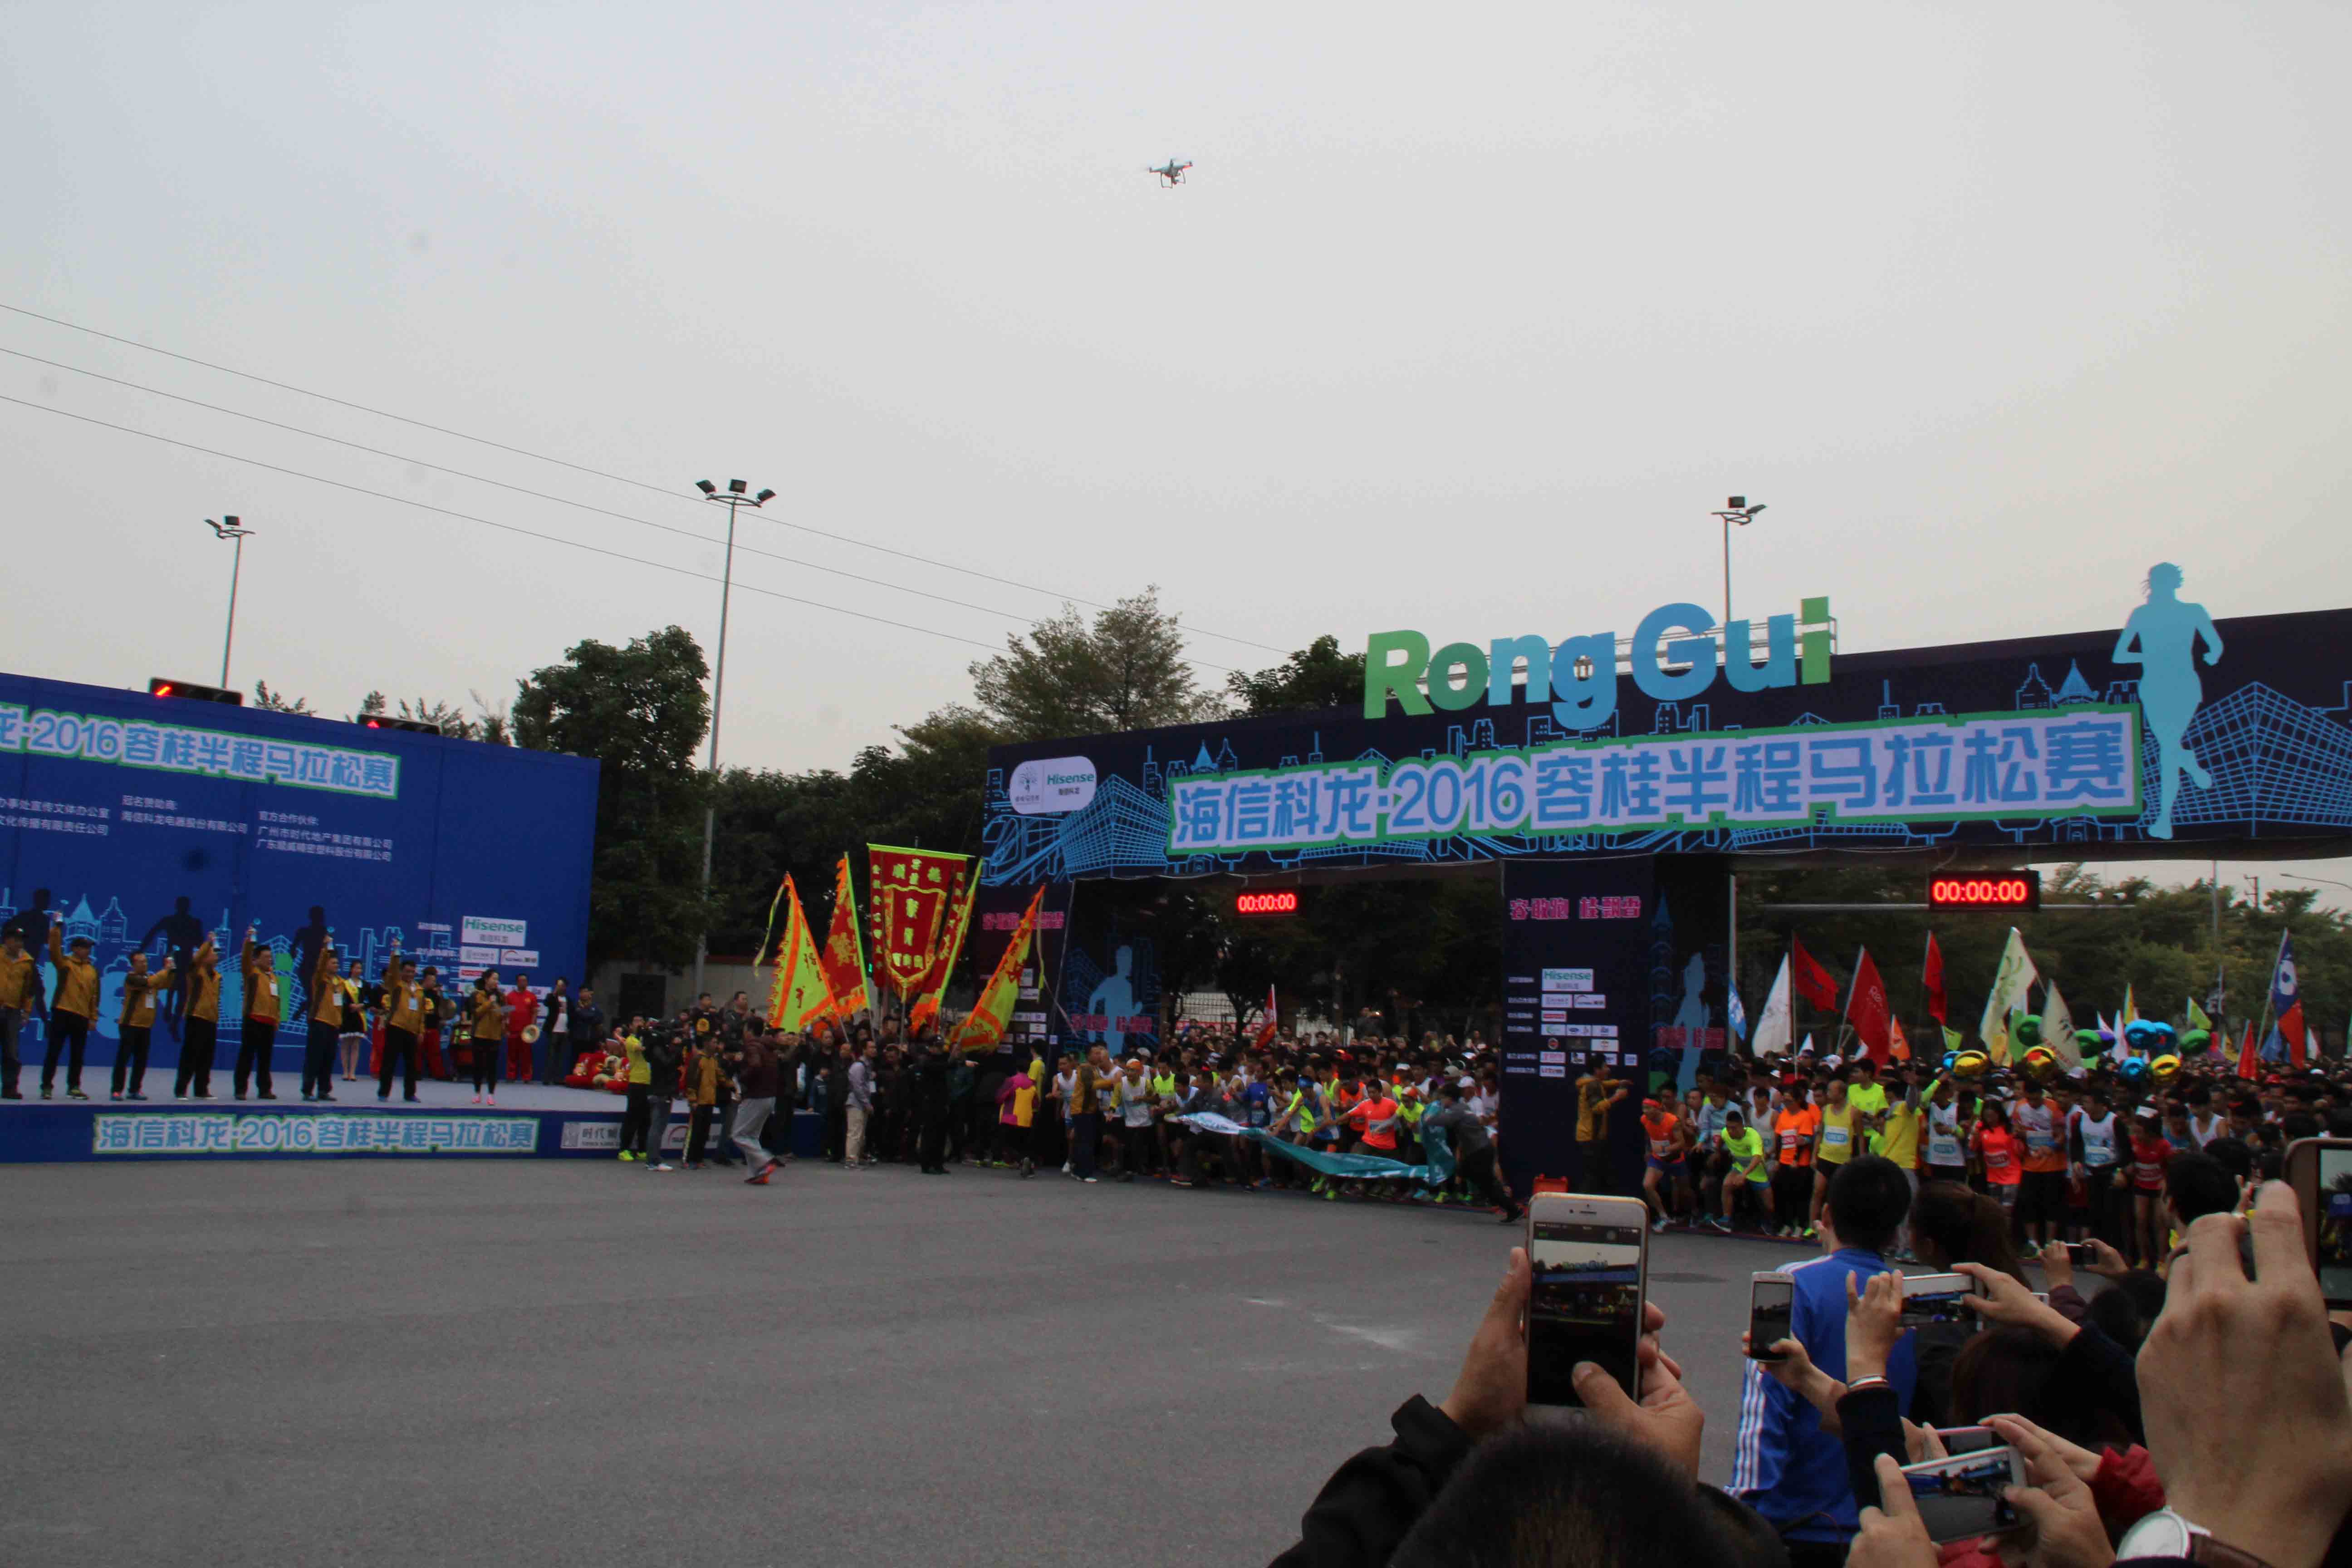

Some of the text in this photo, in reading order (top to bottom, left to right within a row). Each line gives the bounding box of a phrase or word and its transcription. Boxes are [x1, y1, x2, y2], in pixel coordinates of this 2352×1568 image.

[1364, 596, 1830, 730] RongGui
[1047, 773, 1095, 785] Hisense
[1933, 881, 2027, 903] 00:00:00
[1238, 894, 1297, 912] 00:00:00
[465, 917, 524, 932] Hisense
[1544, 970, 1592, 980] Hisense
